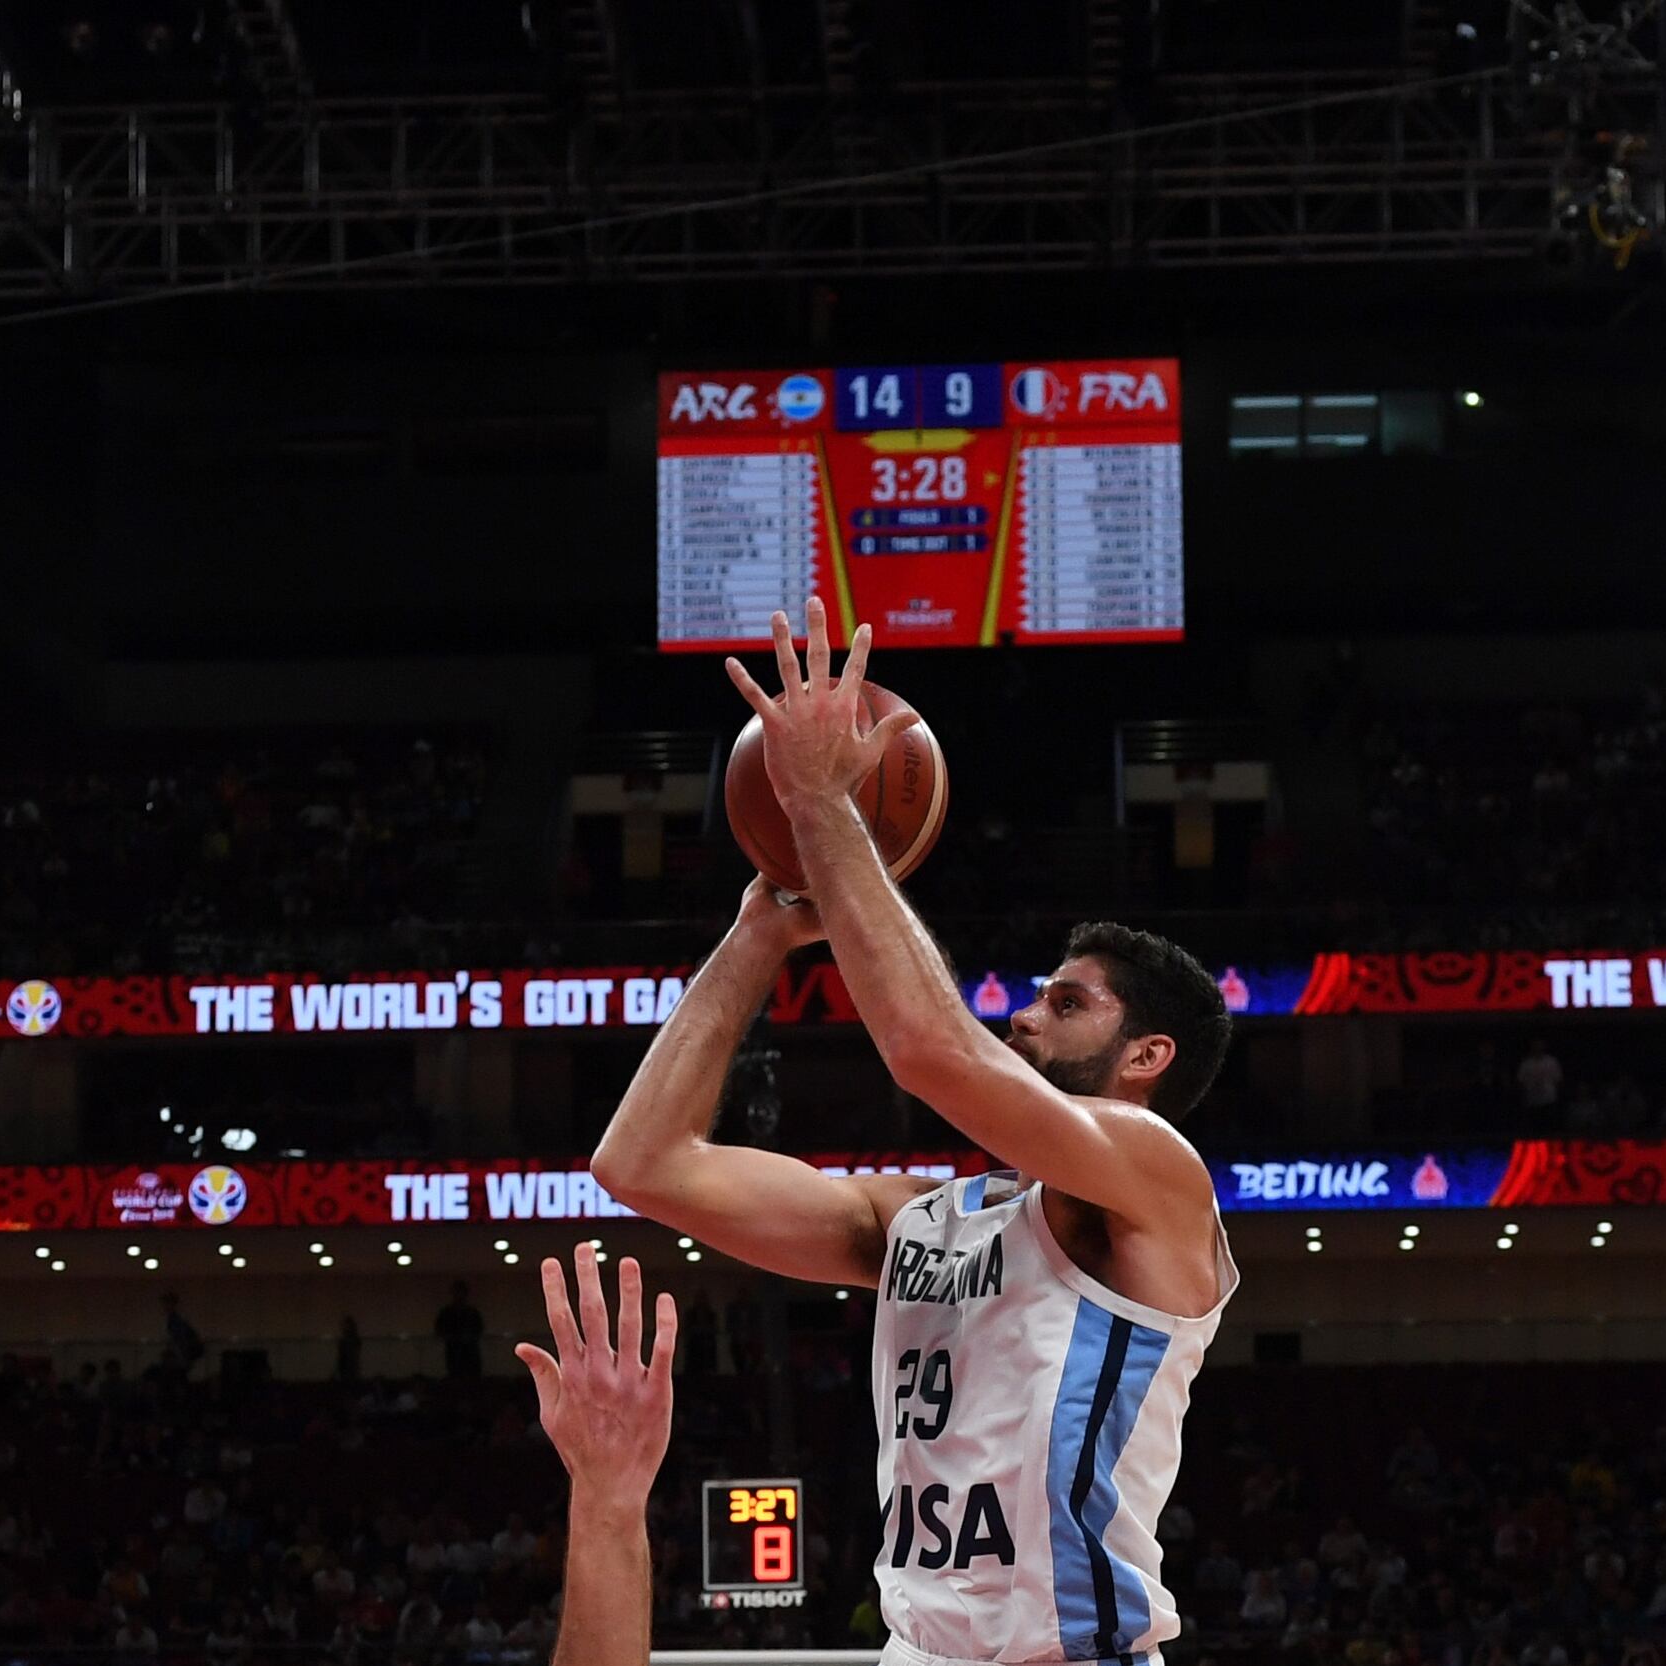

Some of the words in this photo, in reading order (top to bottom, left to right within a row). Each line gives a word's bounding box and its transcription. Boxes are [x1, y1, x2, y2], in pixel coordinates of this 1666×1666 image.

[849, 374, 903, 418] 14
[945, 373, 973, 416] 9
[1078, 372, 1168, 412] FRA
[871, 457, 967, 501] 3:28
[189, 985, 274, 1033] THE
[290, 970, 502, 1031] WORLD'S
[524, 977, 614, 1026] GOT
[623, 977, 683, 1024] GA
[1544, 959, 1633, 1008] THE
[384, 1173, 469, 1221] THE
[485, 1171, 641, 1218] WORL
[895, 1349, 953, 1440] 29
[730, 1489, 796, 1522] 3:27
[754, 1527, 791, 1580] 8
[730, 1590, 807, 1608] TISSOT
